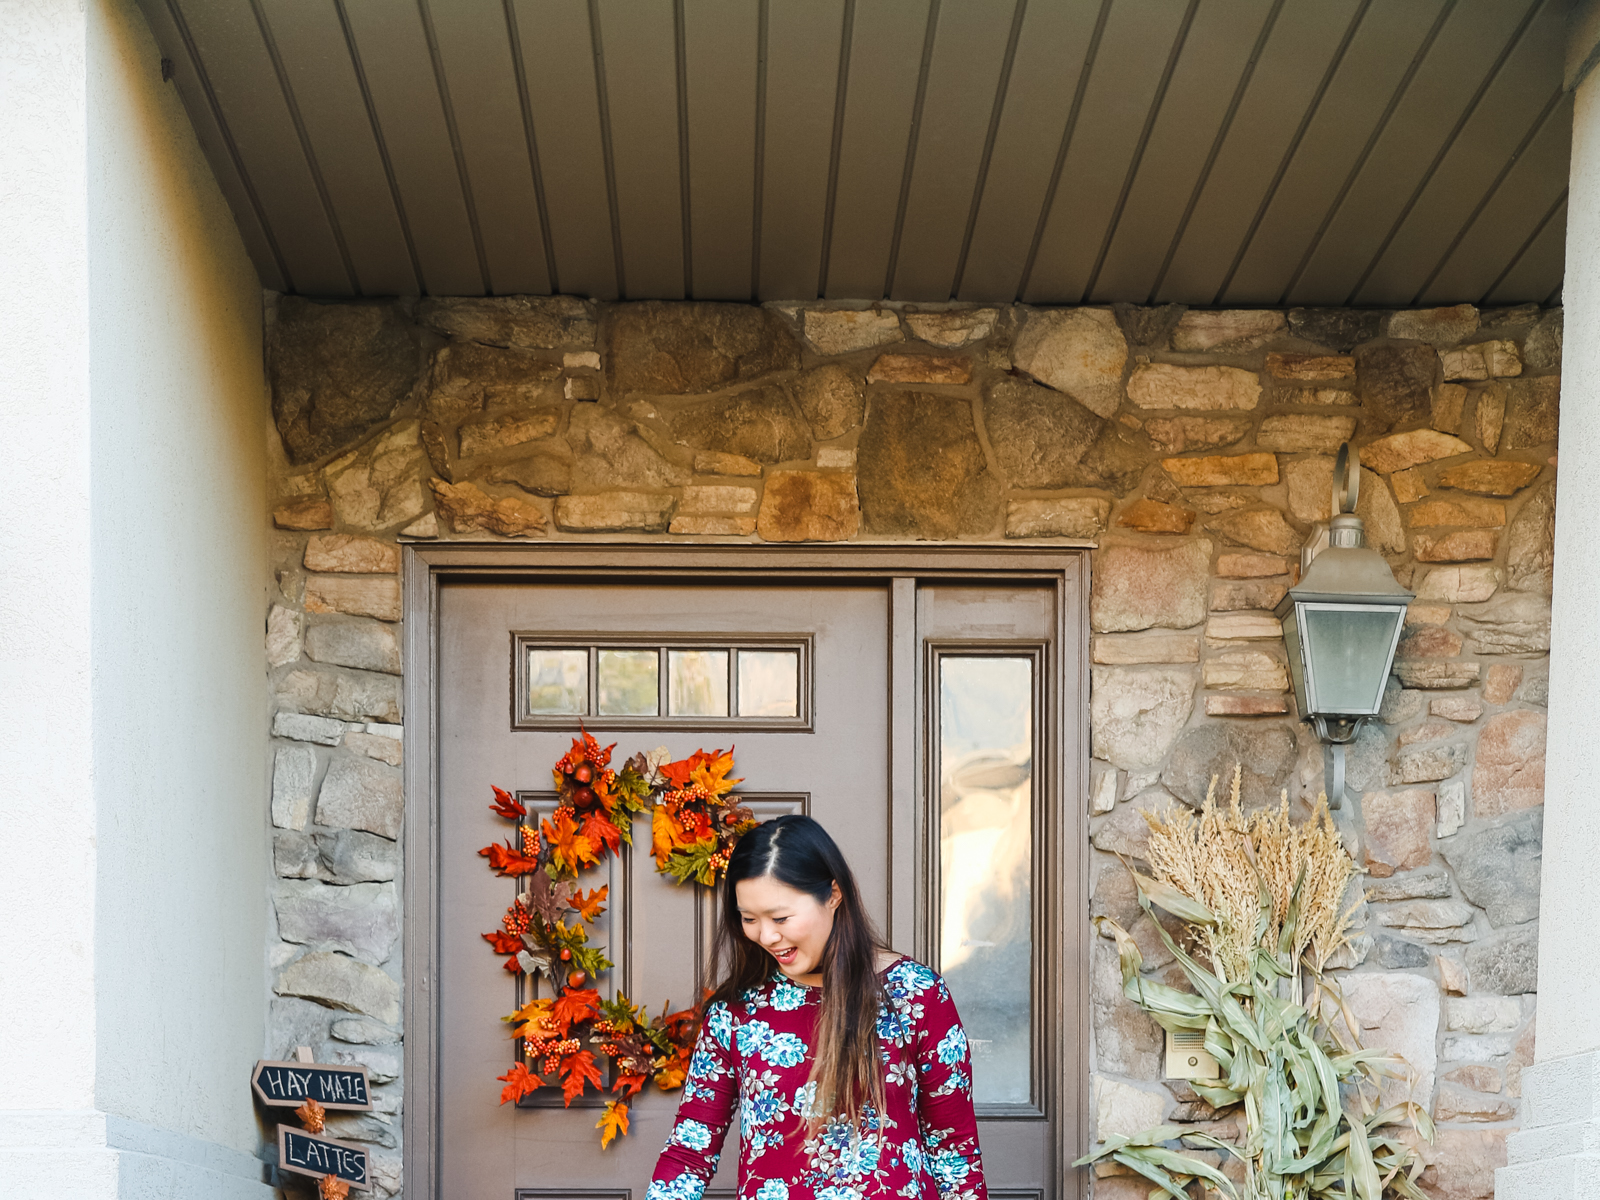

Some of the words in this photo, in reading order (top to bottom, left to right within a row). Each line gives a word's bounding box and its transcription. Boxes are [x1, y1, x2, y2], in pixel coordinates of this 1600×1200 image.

[266, 1069, 313, 1097] HAY
[319, 1074, 366, 1103] MAZE
[288, 1133, 365, 1181] LATTES
